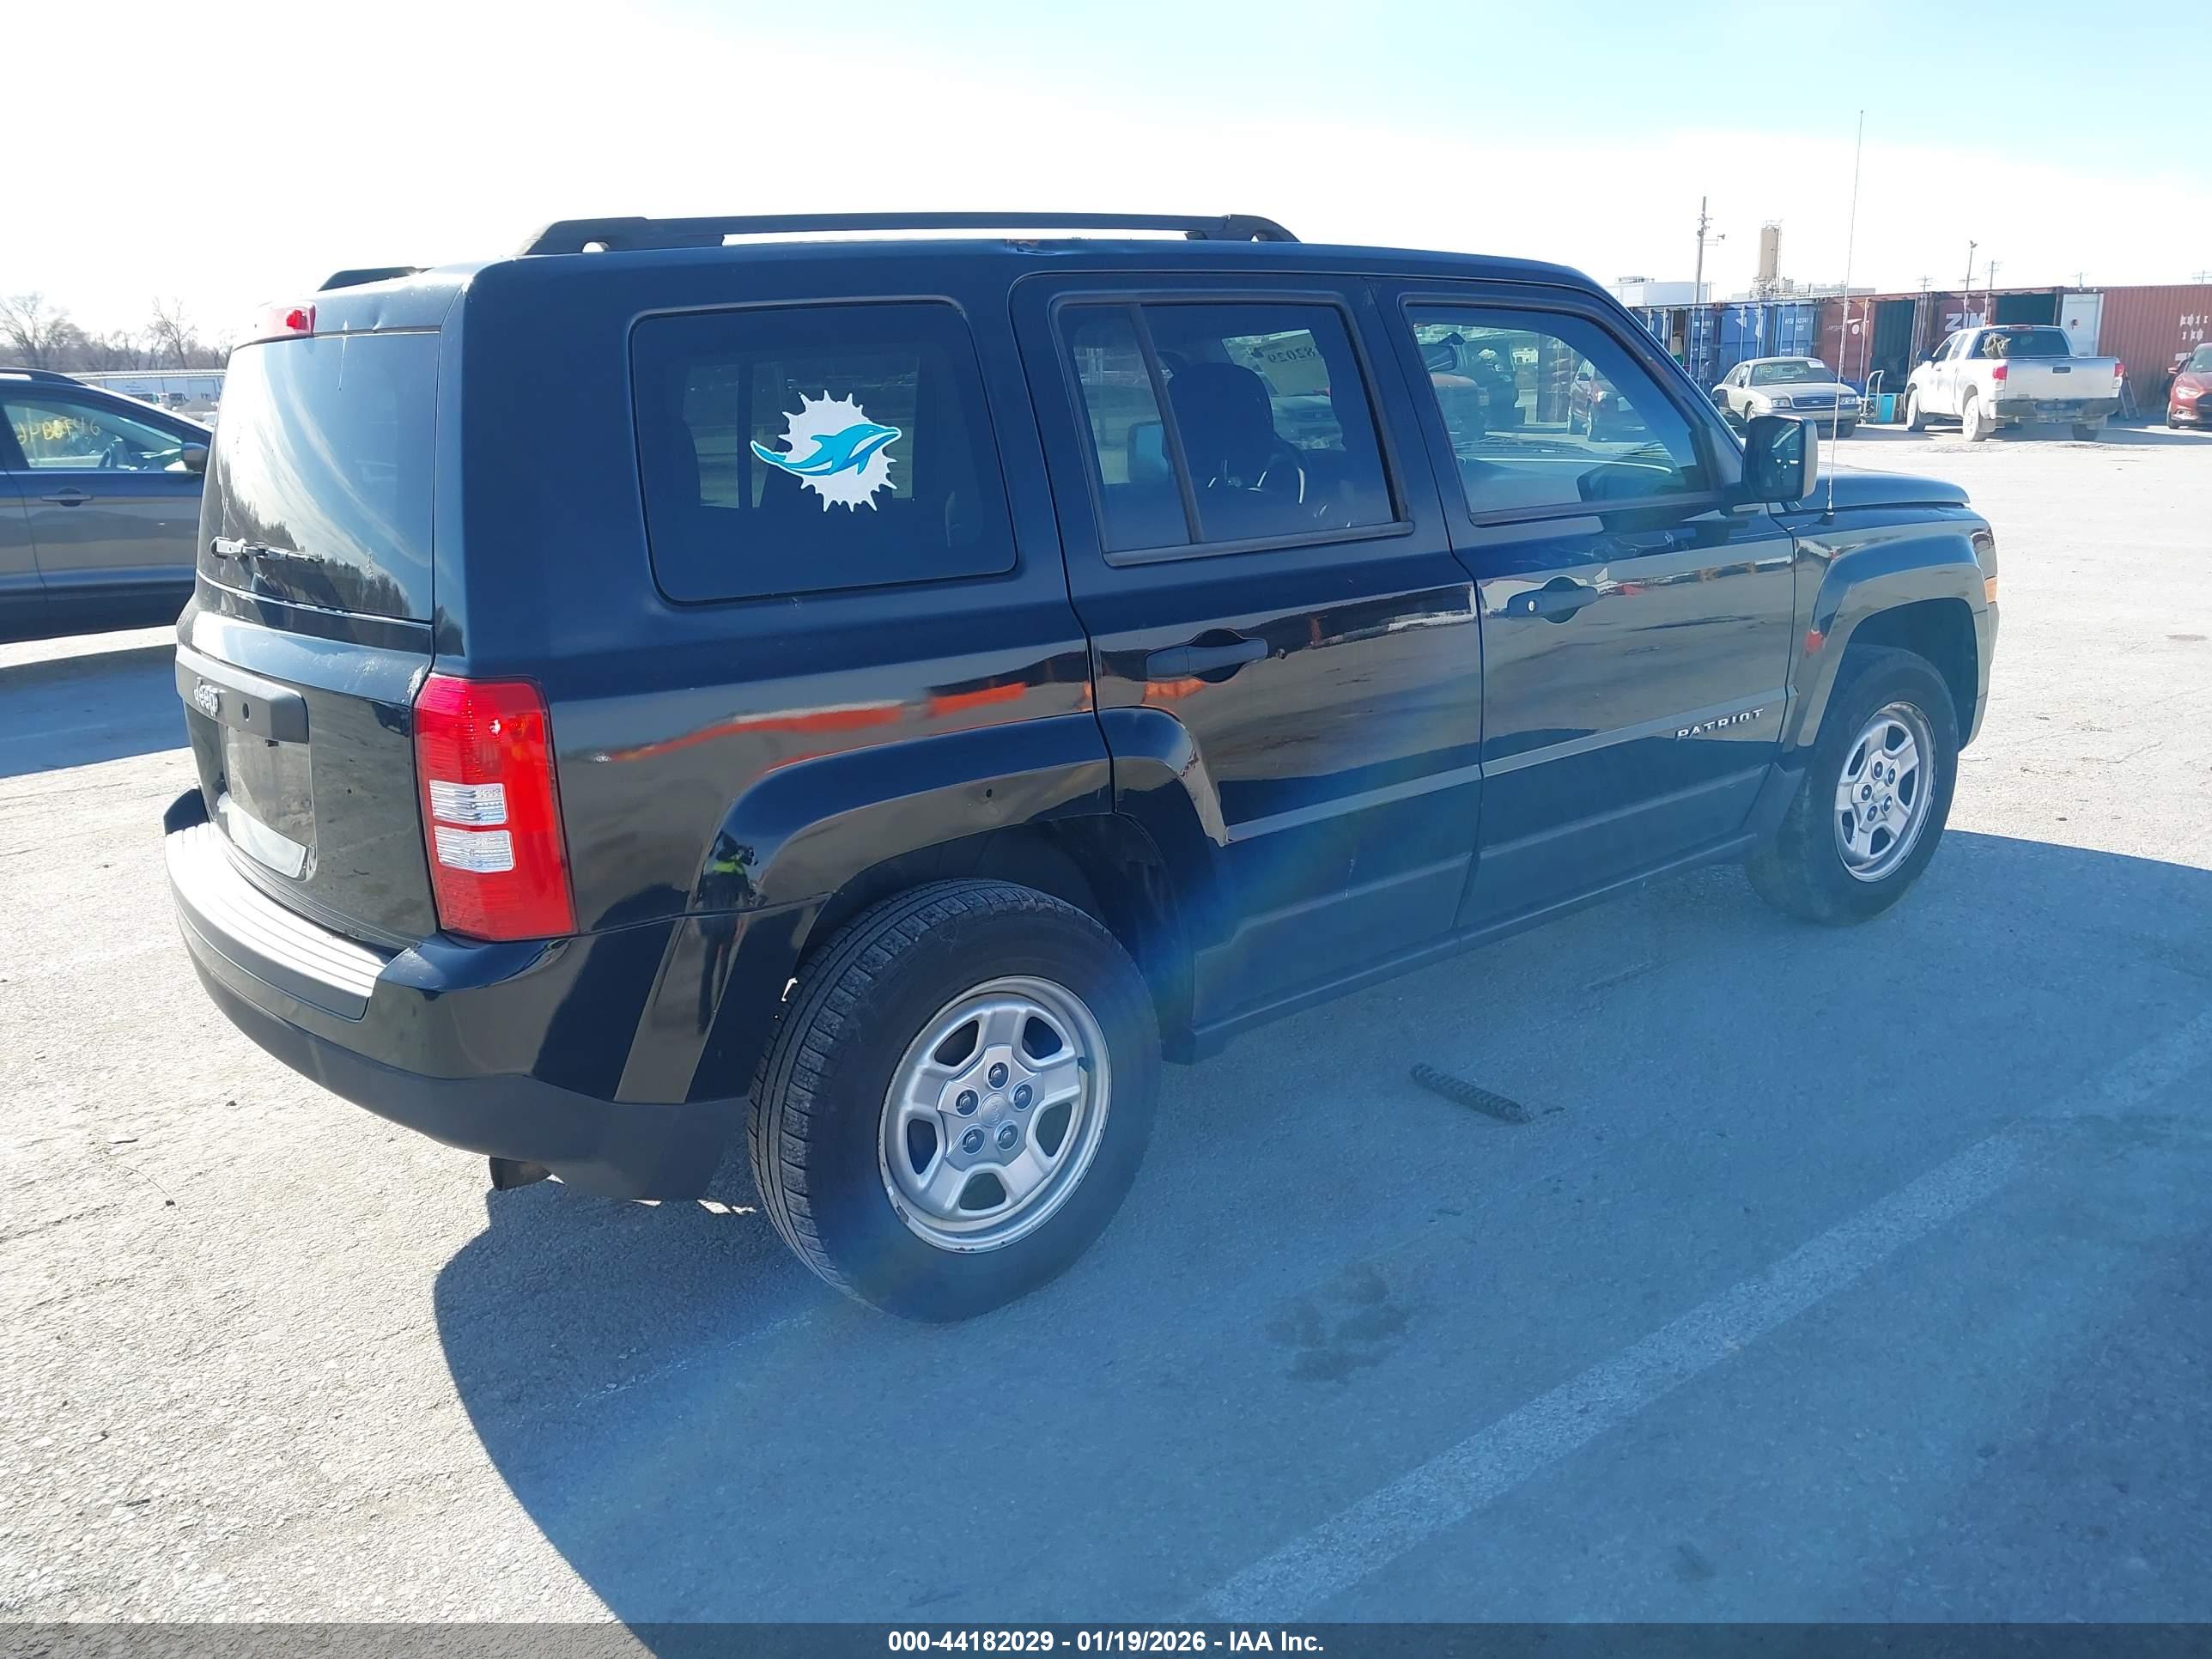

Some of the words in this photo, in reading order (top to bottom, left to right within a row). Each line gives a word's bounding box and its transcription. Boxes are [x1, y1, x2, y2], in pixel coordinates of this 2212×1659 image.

[1944, 312, 1985, 331] ZIM
[193, 676, 219, 718] Jeep
[1676, 708, 1764, 738] PATRIOT
